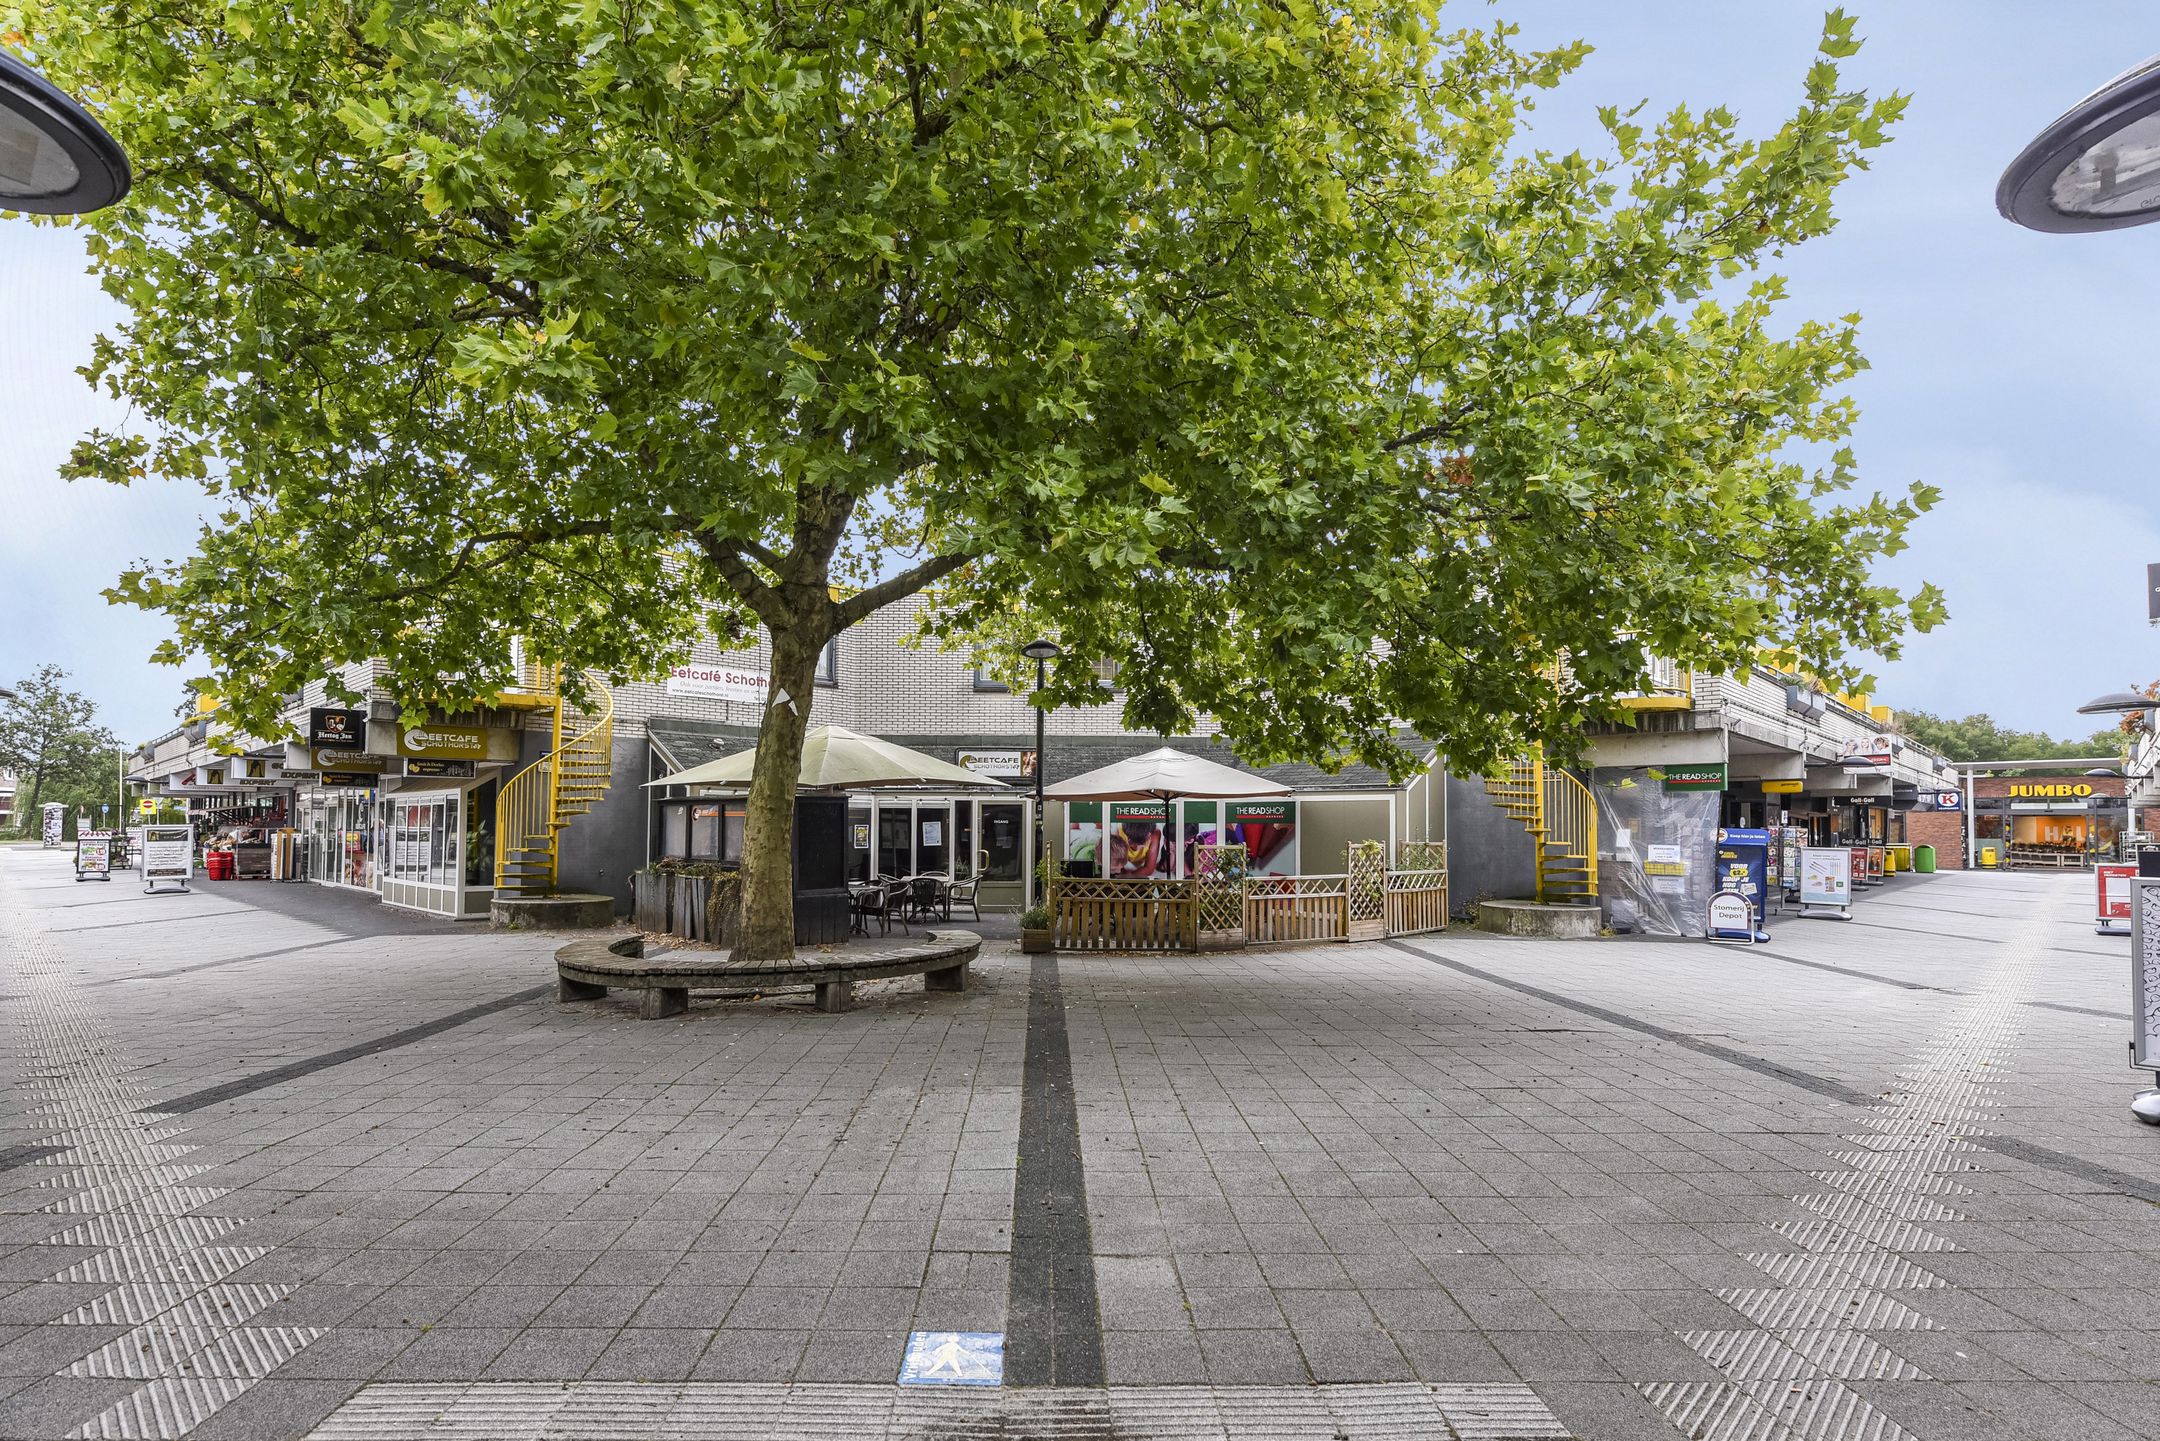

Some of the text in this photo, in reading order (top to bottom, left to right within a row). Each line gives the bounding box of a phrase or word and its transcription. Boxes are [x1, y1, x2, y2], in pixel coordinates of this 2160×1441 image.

[671, 665, 771, 688] Eetcafé Schoth
[317, 731, 353, 740] Hertog Jan
[428, 733, 479, 743] EETCAFE
[421, 740, 474, 749] SCHOTHORST
[2008, 784, 2092, 798] JUMBO
[1116, 807, 1130, 815] THE
[1130, 807, 1150, 815] READ
[1236, 806, 1286, 815] THE READ SHOP
[1713, 904, 1745, 912] Stomerij
[903, 1331, 928, 1380] Vrijhouden
